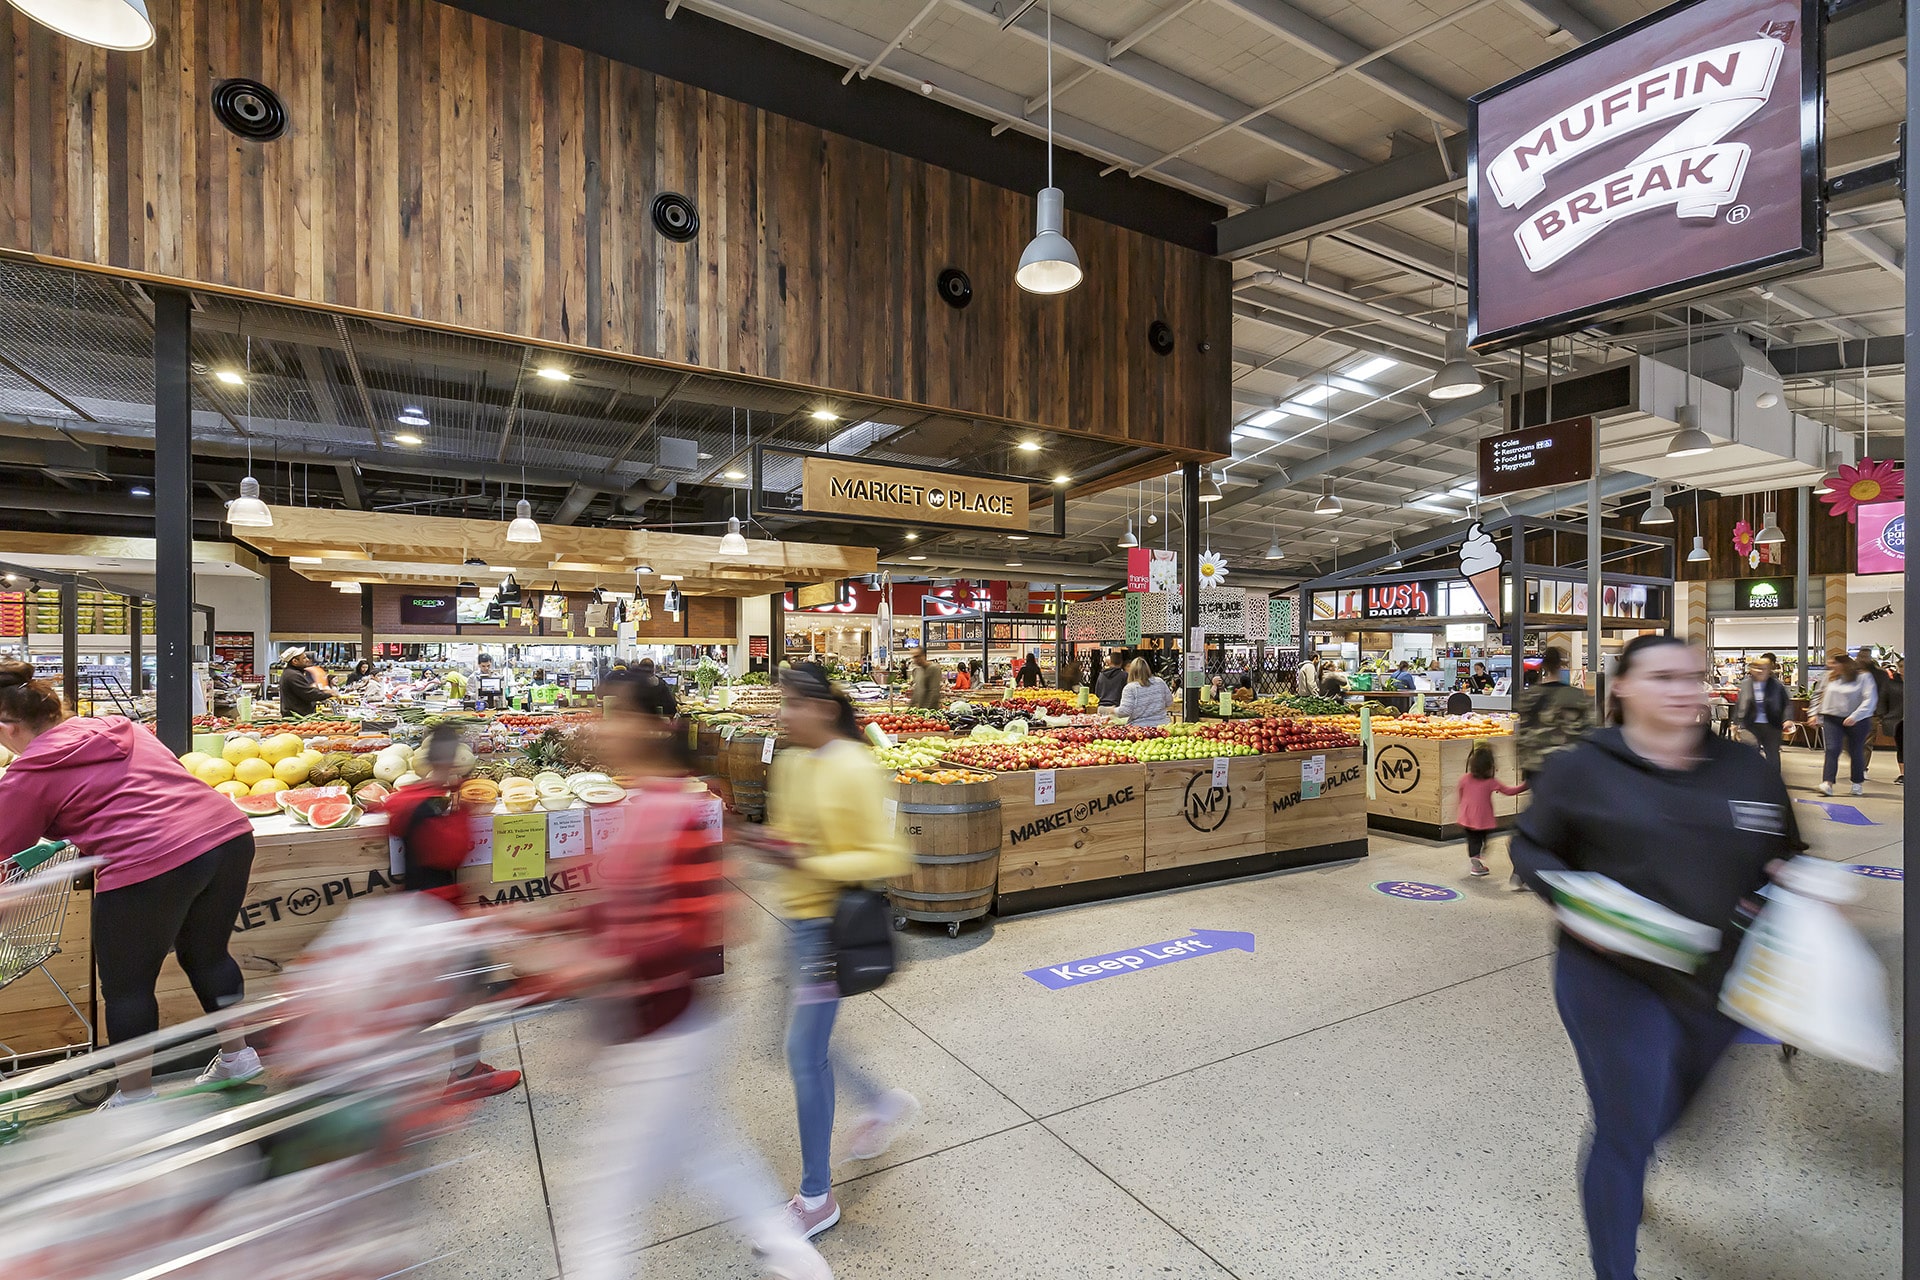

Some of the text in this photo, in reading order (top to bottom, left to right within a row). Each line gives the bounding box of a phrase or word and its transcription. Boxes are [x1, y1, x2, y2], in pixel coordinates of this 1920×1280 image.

[1514, 52, 1740, 172] MUFFIN
[1534, 153, 1718, 241] BREAK
[1501, 445, 1534, 454] Restrooms
[1501, 452, 1531, 463] Food Hall
[1501, 459, 1534, 470] Playground
[830, 476, 925, 507] MARKET
[948, 490, 1014, 516] PLACE
[1130, 575, 1149, 583] thanks
[1369, 608, 1411, 617] DAIRY
[1382, 758, 1413, 780] MP
[1327, 766, 1361, 790] PLACE
[1010, 808, 1073, 845] MARKET
[1088, 786, 1135, 815] PLACE
[554, 831, 579, 844] $3.29
[904, 826, 922, 836] ACE
[478, 862, 593, 907] MARKET
[1390, 886, 1431, 897] Left
[1397, 882, 1448, 896] Keep
[1049, 939, 1213, 982] Keep Left
